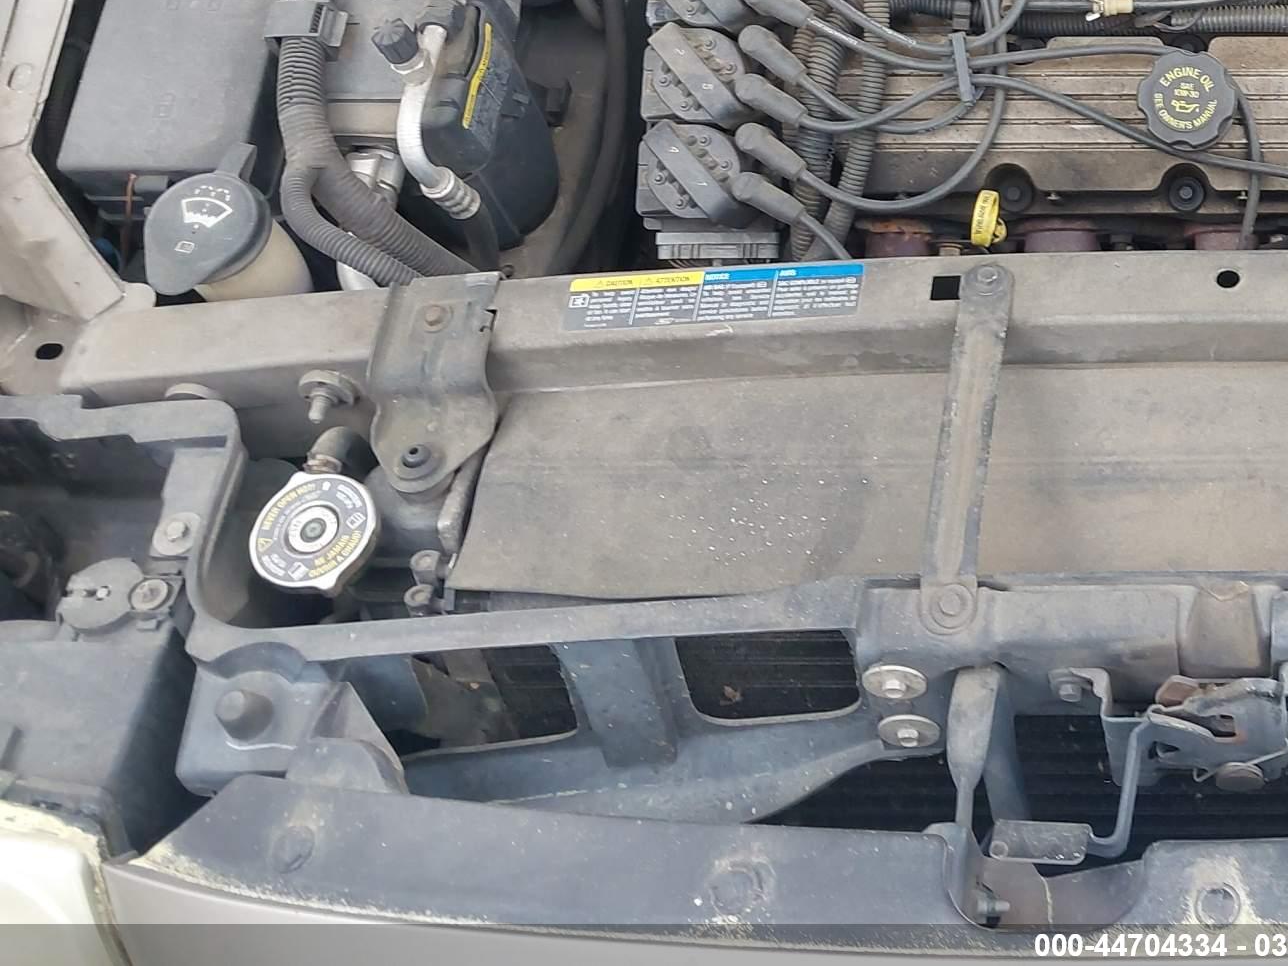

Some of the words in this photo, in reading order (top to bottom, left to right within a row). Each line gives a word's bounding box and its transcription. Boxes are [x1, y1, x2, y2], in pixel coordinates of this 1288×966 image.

[1159, 66, 1202, 87] ENGINE
[1200, 75, 1215, 92] OIL
[1153, 93, 1164, 110] SEE
[1159, 110, 1193, 130] OWNER'S
[1192, 99, 1218, 127] MANUAL
[277, 489, 298, 509] OPEN
